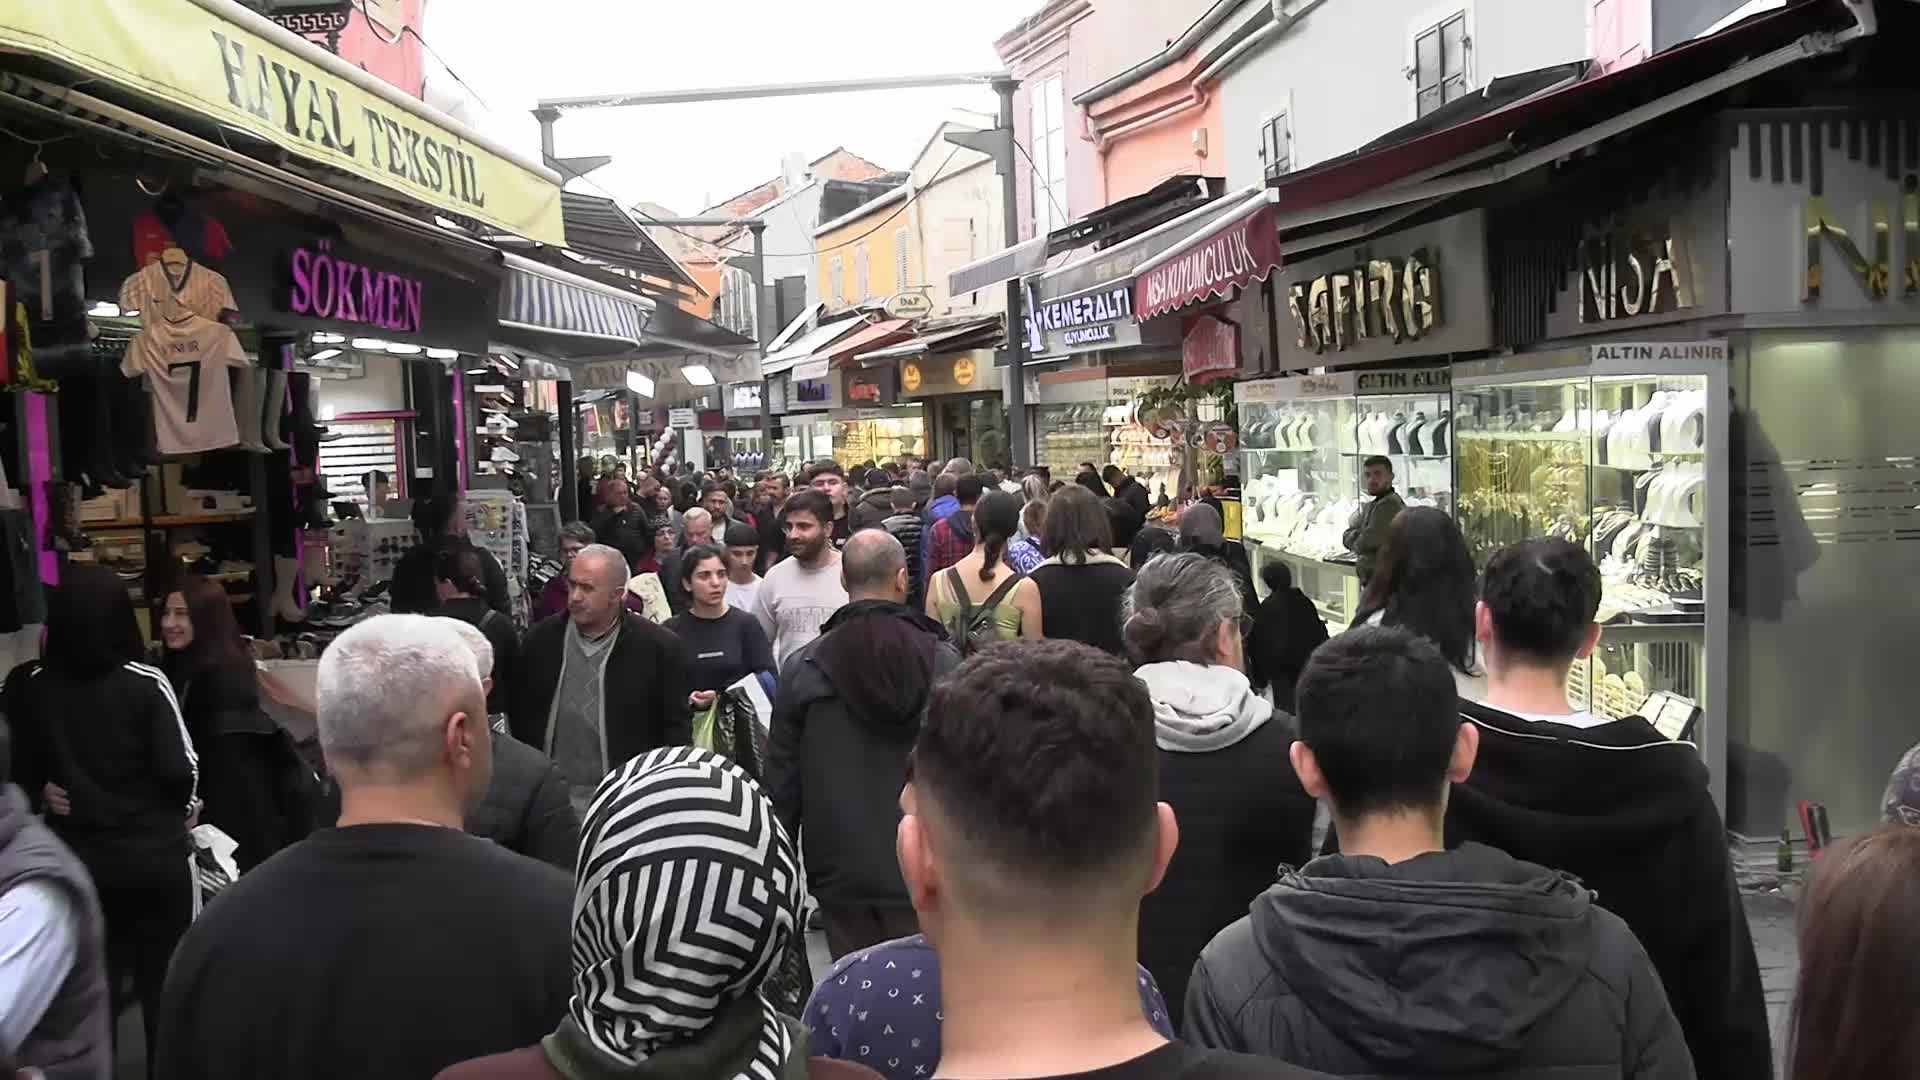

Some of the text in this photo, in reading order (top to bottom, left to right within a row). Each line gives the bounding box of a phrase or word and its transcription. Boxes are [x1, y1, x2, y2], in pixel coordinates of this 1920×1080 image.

[211, 30, 355, 158] HAYAL
[291, 239, 423, 333] SÖKMEN
[1042, 287, 1131, 330] KEMERALTI
[1596, 346, 1723, 360] ALTIN ALINIR
[168, 360, 201, 422] 7
